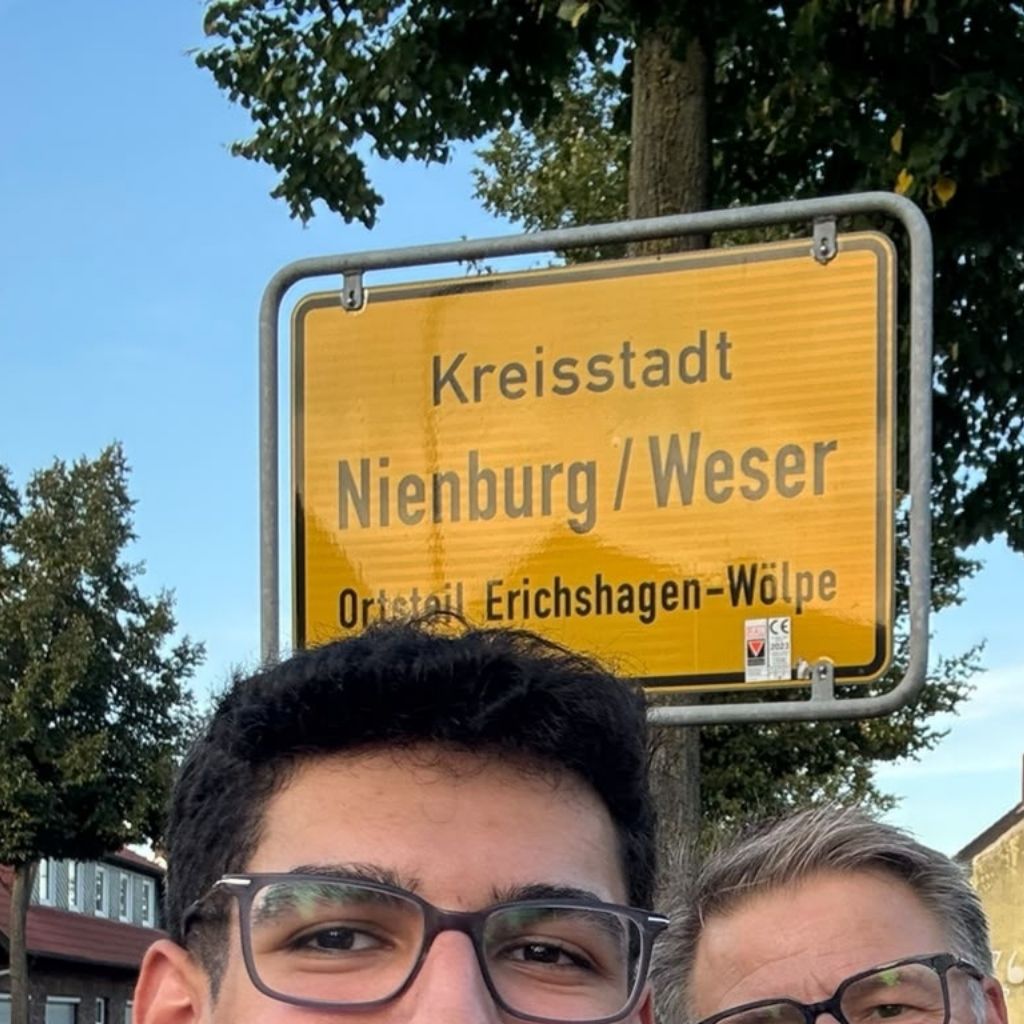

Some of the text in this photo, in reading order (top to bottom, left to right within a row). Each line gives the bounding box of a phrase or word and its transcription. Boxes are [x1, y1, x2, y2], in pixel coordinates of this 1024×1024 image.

[433, 329, 732, 406] Kreisstadt
[338, 450, 597, 534] Nienburg
[648, 432, 838, 508] Weser
[486, 561, 837, 624] Erichshagen-Wölpe
